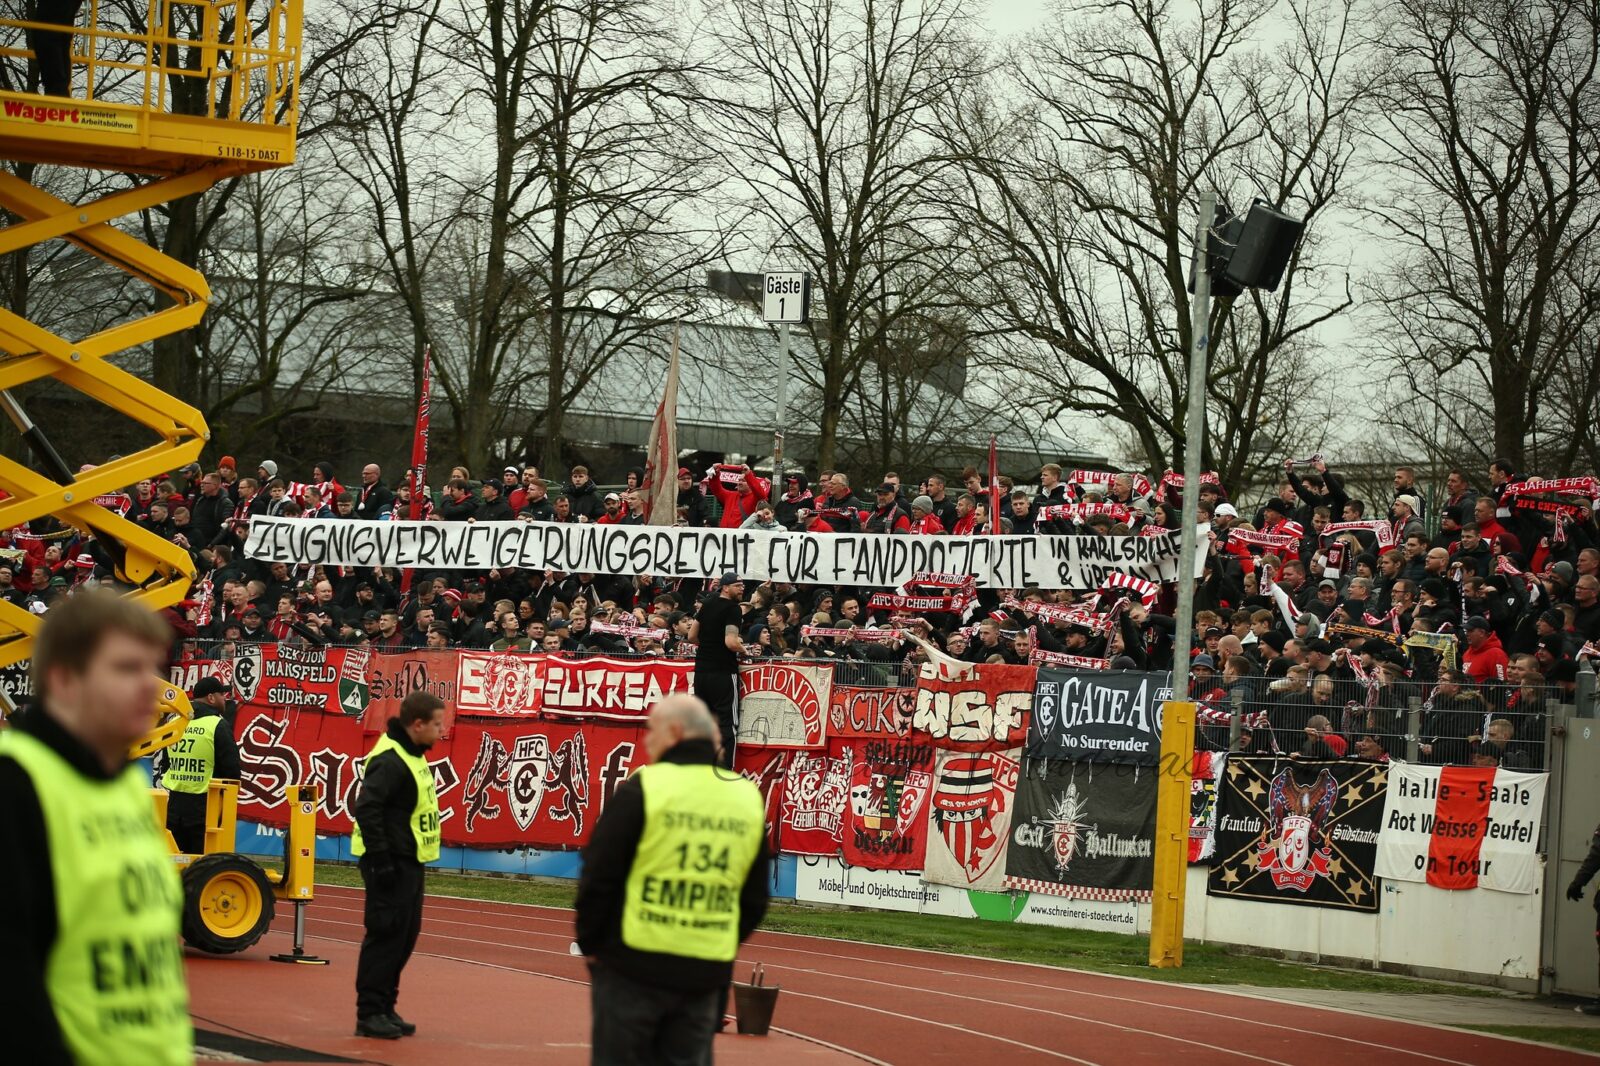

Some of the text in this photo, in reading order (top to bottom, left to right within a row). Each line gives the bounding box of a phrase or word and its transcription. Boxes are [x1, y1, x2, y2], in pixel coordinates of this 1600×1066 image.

[4, 100, 79, 124] Wagert
[82, 111, 116, 119] vermietet
[81, 118, 133, 129] Arbeitsbühnen
[226, 147, 255, 159] 118-15
[259, 149, 279, 160] DAST
[767, 276, 800, 294] Gäste
[779, 298, 785, 319] 1
[1521, 480, 1561, 491] JAHRE
[1565, 477, 1591, 487] HFC
[252, 520, 755, 578] ZEUGNISVERWEIGERUNGSRECHT
[768, 535, 818, 582] FÜR
[1051, 536, 1070, 561] IN
[915, 572, 929, 581] HFC
[1057, 561, 1074, 587] &
[872, 595, 944, 609] HFC CHEMIE
[278, 645, 326, 663] SEKTION
[266, 660, 337, 683] MANSFELD
[1041, 684, 1055, 694] HFC
[850, 691, 896, 733] CTK
[913, 688, 1032, 742] WSF
[518, 742, 543, 759] HFC
[1061, 734, 1149, 752] No Surrender
[169, 757, 206, 773] MPIRE
[803, 759, 821, 771] HFC
[831, 762, 843, 773] FC
[988, 754, 1019, 786] HFC
[906, 773, 924, 787] HFC
[1399, 777, 1449, 801] Halle
[1476, 781, 1530, 806] Saale
[1058, 826, 1072, 834] HFC
[1220, 815, 1261, 833] Fanclub
[1289, 821, 1305, 829] HFC
[1387, 809, 1533, 843] Rot Weisse Teufel
[676, 842, 729, 873] 134
[1414, 854, 1492, 876] on Tour
[849, 882, 864, 894] und
[867, 882, 940, 902] Objektschreinerei
[1030, 905, 1134, 924] www.schreinerei-stoeckert.de
